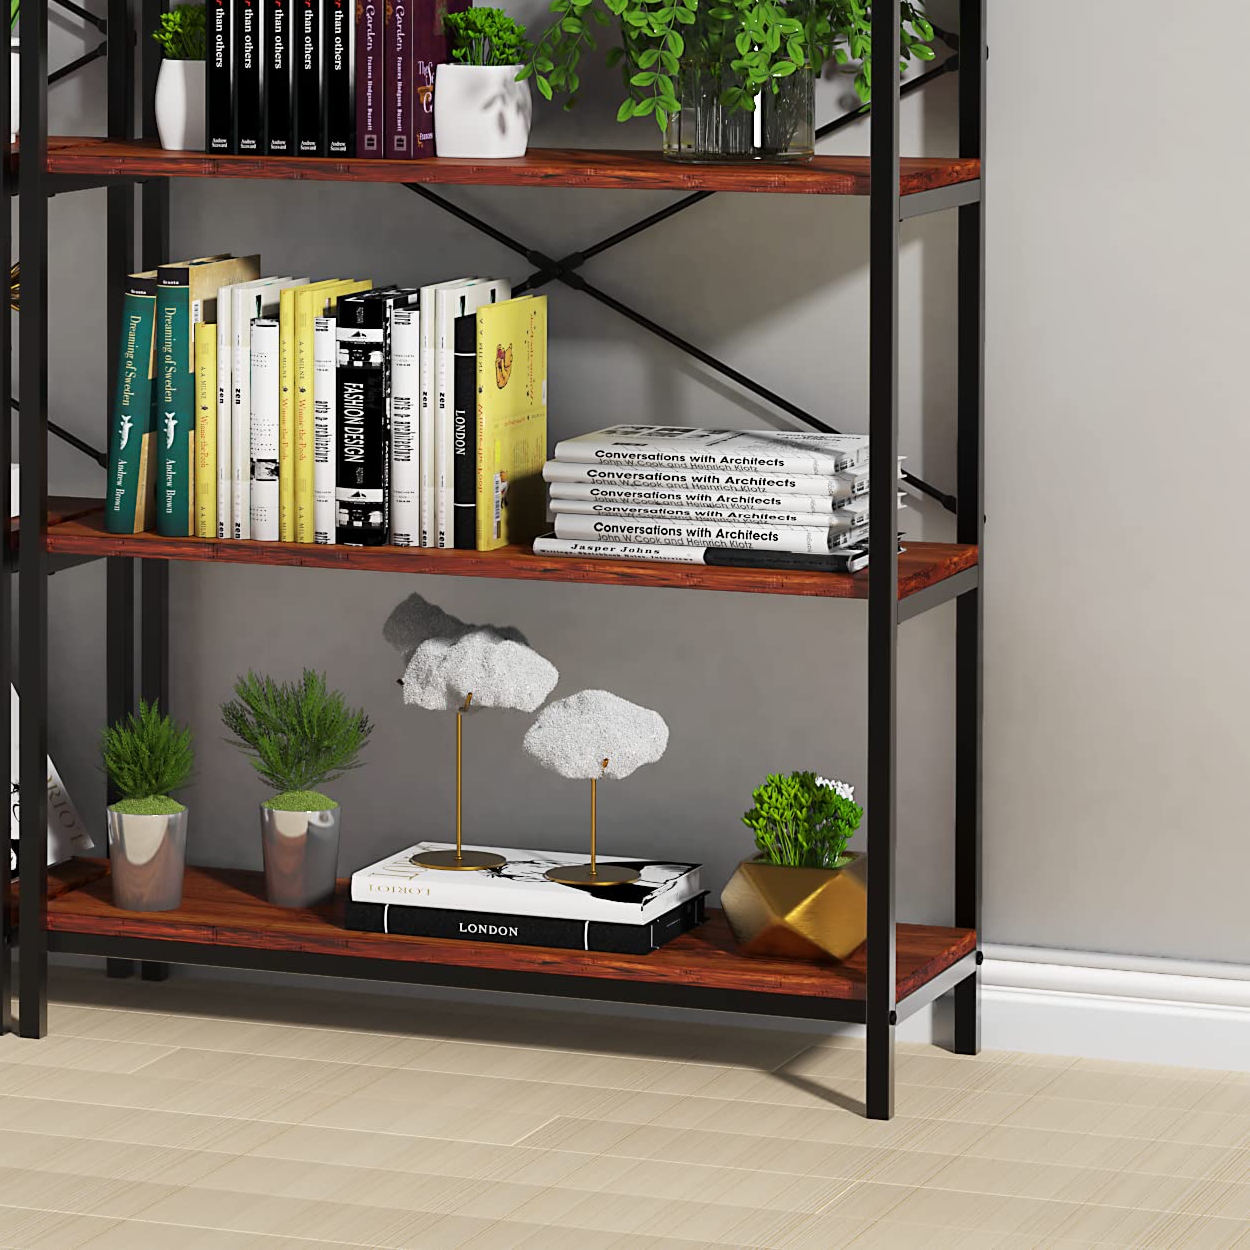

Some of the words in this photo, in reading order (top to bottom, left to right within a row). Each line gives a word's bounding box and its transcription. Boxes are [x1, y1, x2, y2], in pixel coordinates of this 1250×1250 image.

[215, 8, 224, 32] than
[335, 11, 343, 34] than
[366, 5, 375, 50] Garden
[216, 35, 224, 68] others
[335, 37, 343, 70] others
[162, 307, 176, 353] Dreaming
[165, 355, 176, 365] of
[165, 366, 176, 403] Sweden
[344, 382, 363, 425] FASHION
[344, 427, 364, 462] DESIGN
[456, 410, 465, 455] LONDON
[595, 450, 686, 463] Conversations
[689, 454, 715, 463] with
[720, 455, 785, 467] Architects
[166, 459, 175, 488] Andrew
[587, 469, 688, 481] Conversations
[692, 471, 720, 483] with
[725, 473, 796, 488] Architects
[166, 490, 175, 513] Brown
[594, 522, 682, 537] Conversations
[686, 526, 712, 537] with
[716, 528, 779, 542] Architects
[459, 923, 518, 936] LONDON
